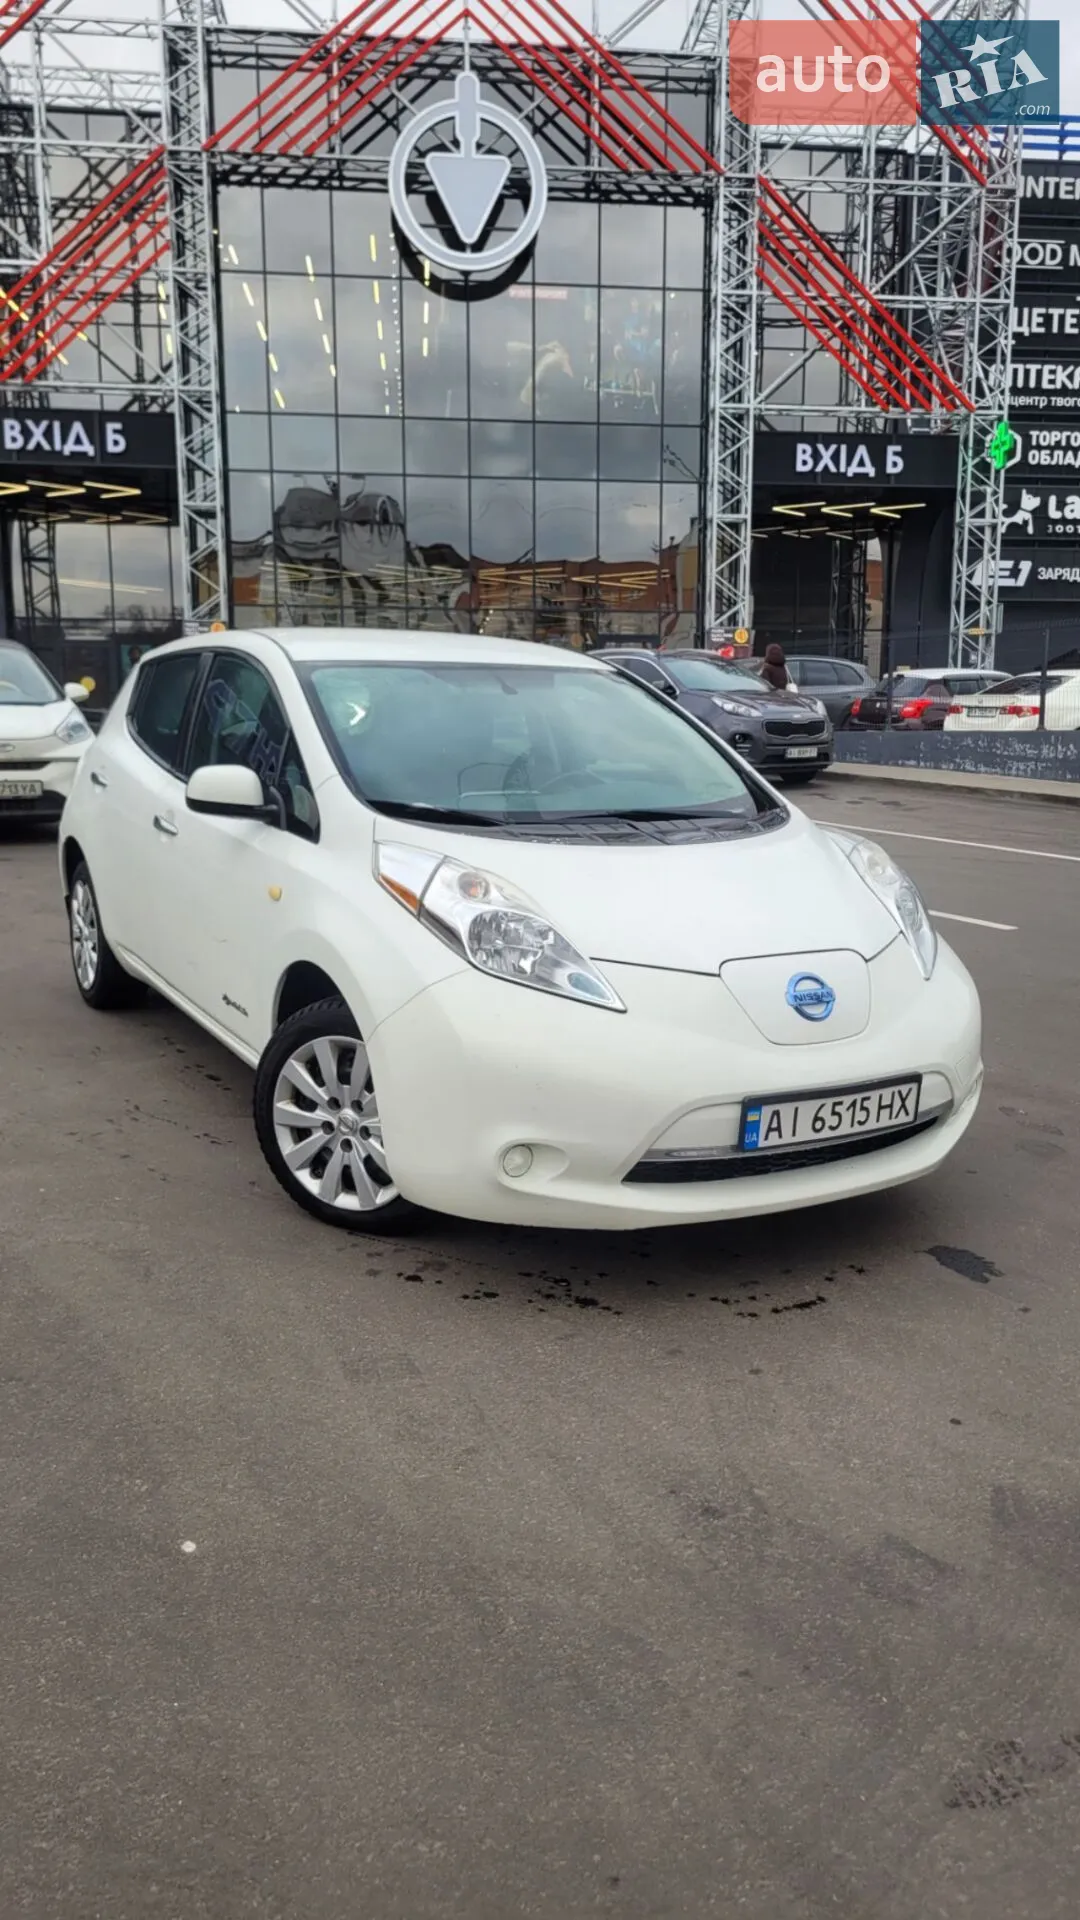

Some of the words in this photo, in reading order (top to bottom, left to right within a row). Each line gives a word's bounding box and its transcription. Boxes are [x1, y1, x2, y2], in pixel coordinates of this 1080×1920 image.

[1001, 242, 1063, 266] OOD
[2, 418, 96, 457] ВХІД
[105, 422, 127, 454] Б
[795, 443, 876, 477] ВХІД
[885, 445, 904, 474] Б
[793, 990, 834, 1002] NISSAN
[744, 1133, 758, 1143] UA
[763, 1107, 799, 1141] AI
